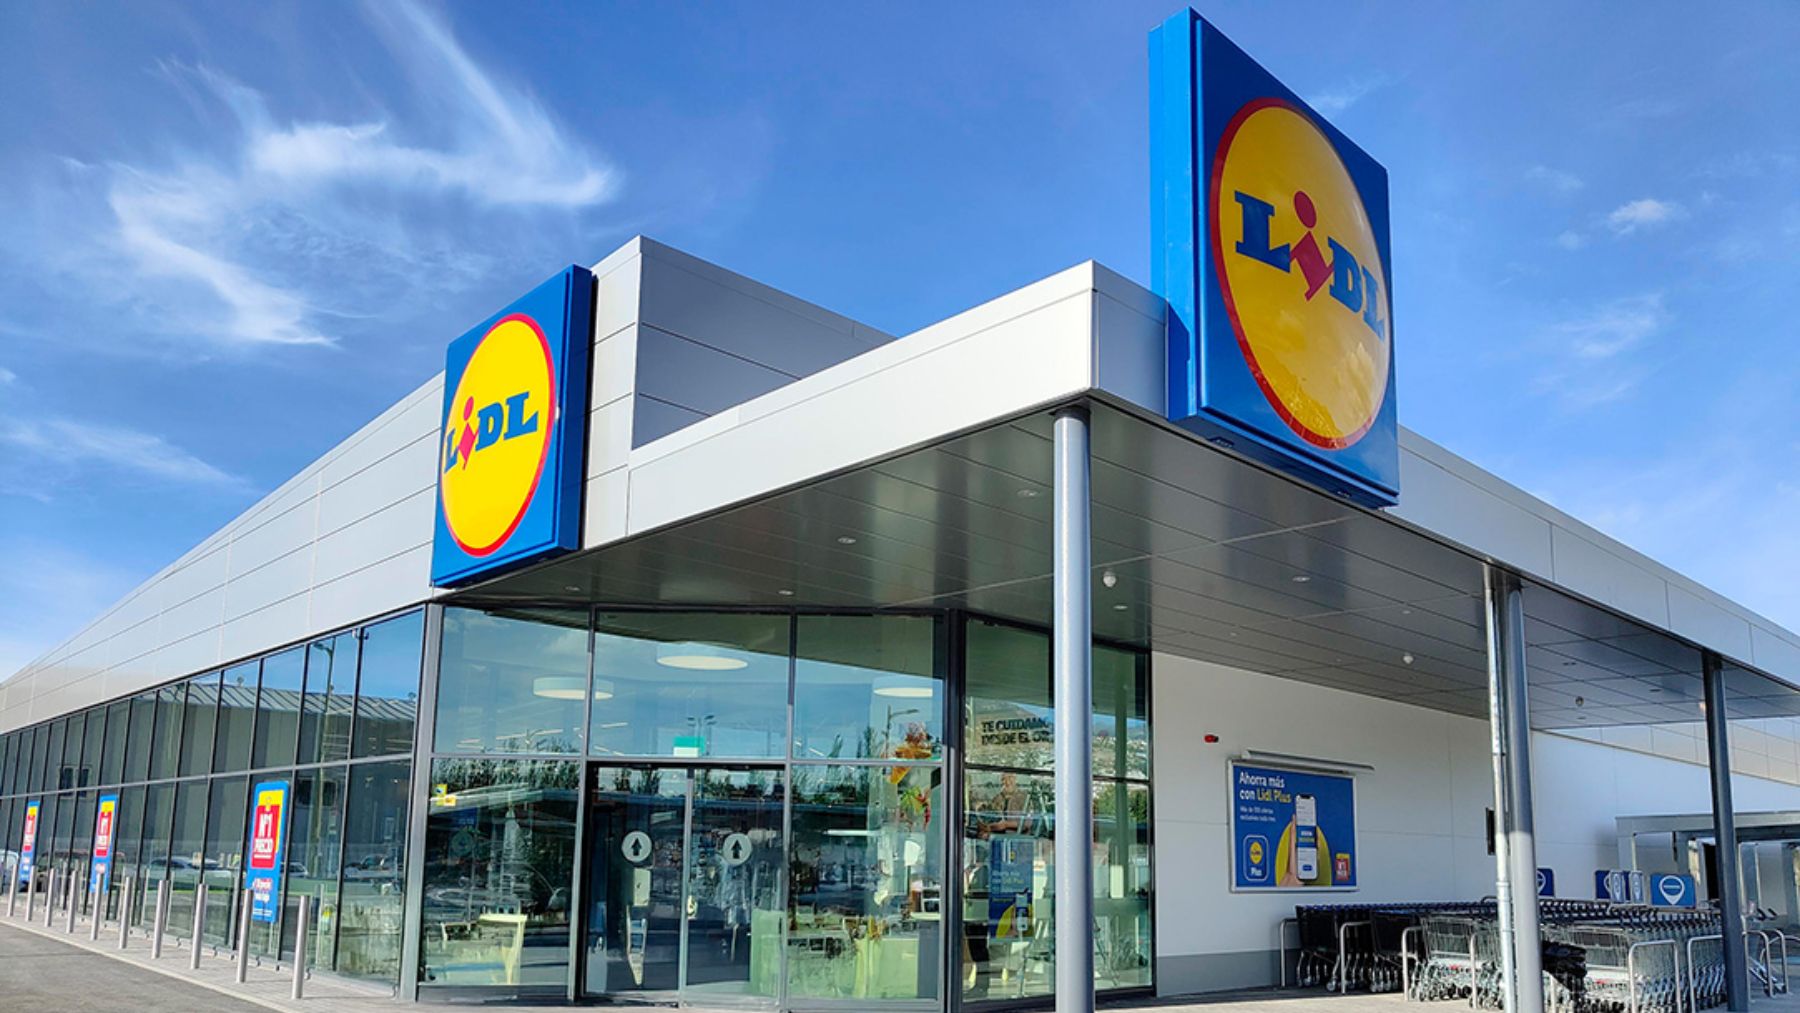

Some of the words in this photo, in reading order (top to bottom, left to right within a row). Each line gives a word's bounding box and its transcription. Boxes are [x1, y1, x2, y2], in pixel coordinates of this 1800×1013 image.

[995, 717, 1053, 732] CUIDAM
[1239, 772, 1267, 786] Ahorra
[1239, 789, 1255, 800] con
